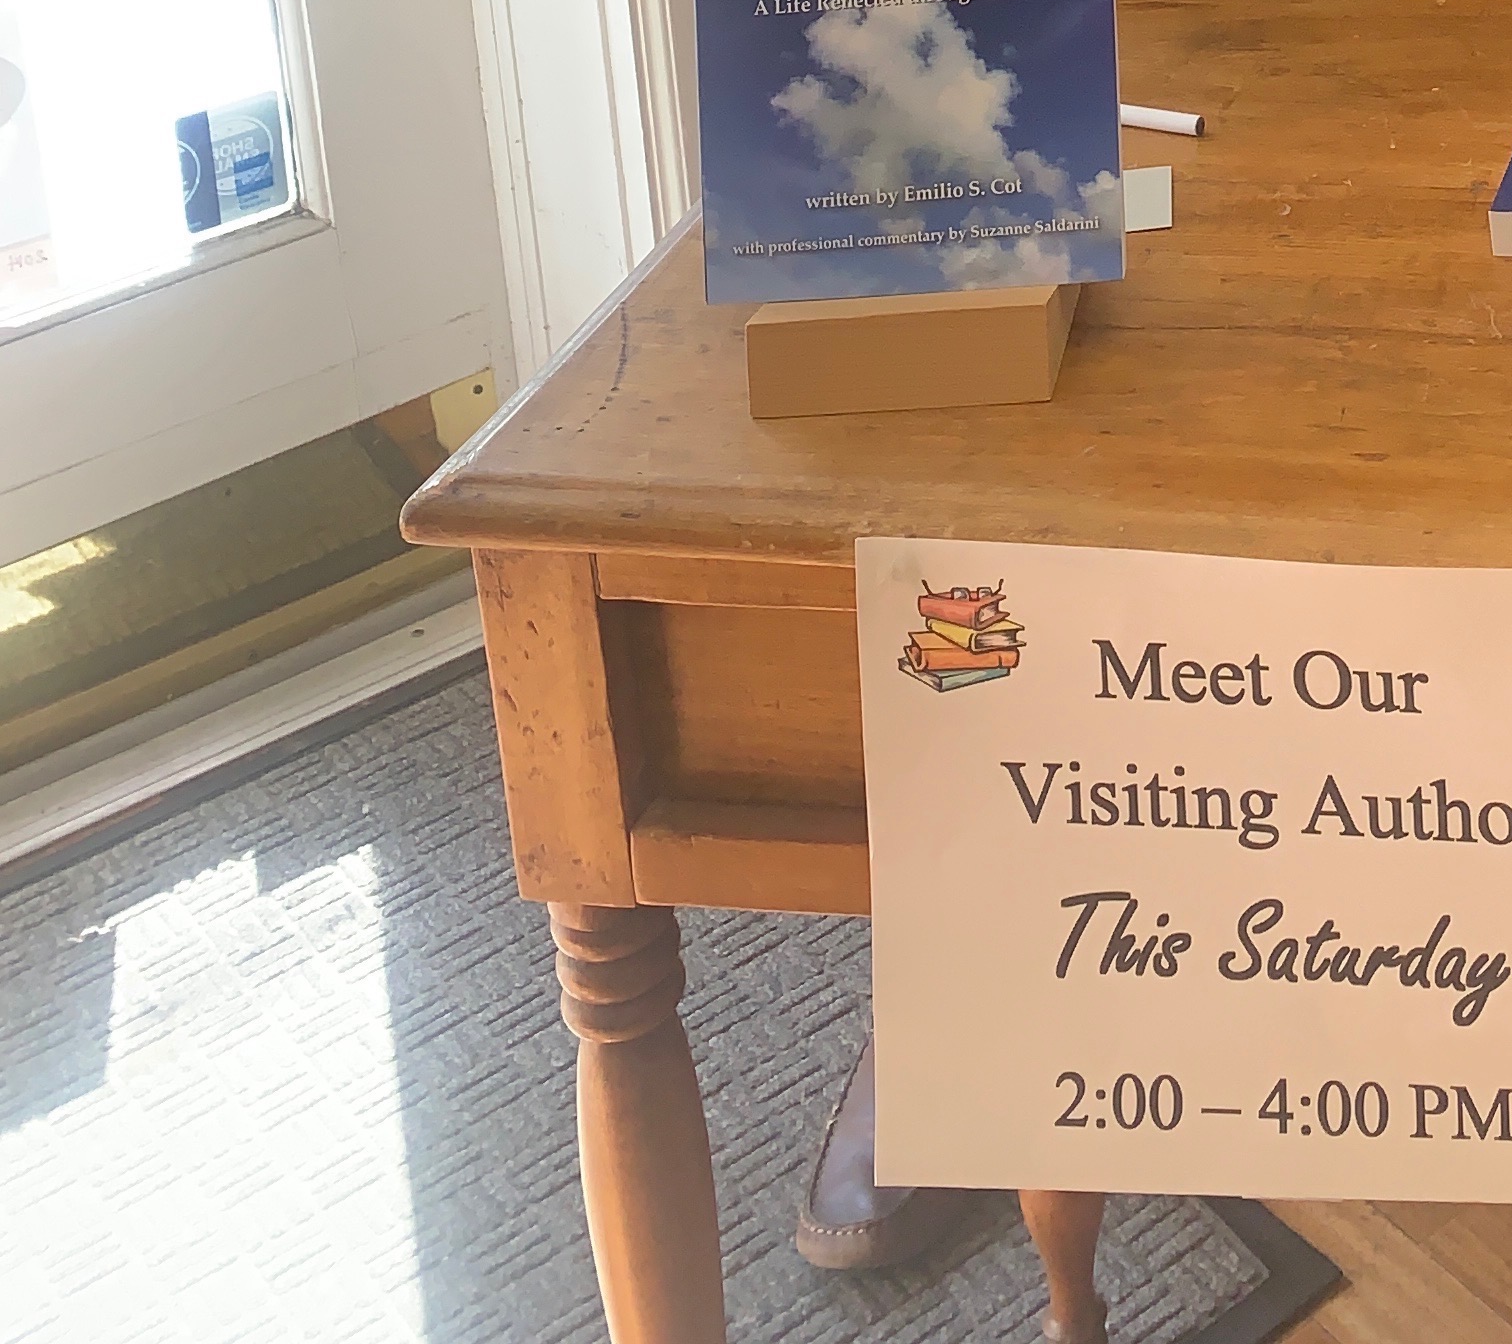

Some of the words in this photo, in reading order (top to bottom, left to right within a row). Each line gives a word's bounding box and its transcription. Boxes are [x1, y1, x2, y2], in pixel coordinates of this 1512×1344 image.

[804, 189, 872, 211] written
[875, 187, 900, 211] by
[903, 182, 964, 204] Emilio
[968, 180, 986, 199] S.
[732, 239, 765, 257] with
[767, 234, 855, 258] professional
[857, 228, 946, 249] commentary
[948, 224, 968, 243] by
[969, 221, 1031, 239] Suzanne
[1033, 216, 1100, 235] Saldarini
[1091, 638, 1272, 708] Meet
[1292, 649, 1430, 715] Our
[1000, 759, 1281, 851] Visiting
[1055, 890, 1193, 981] This
[1217, 897, 1512, 1028] Saturday
[1054, 1070, 1185, 1132] 2:00
[1257, 1077, 1390, 1138] 4:00
